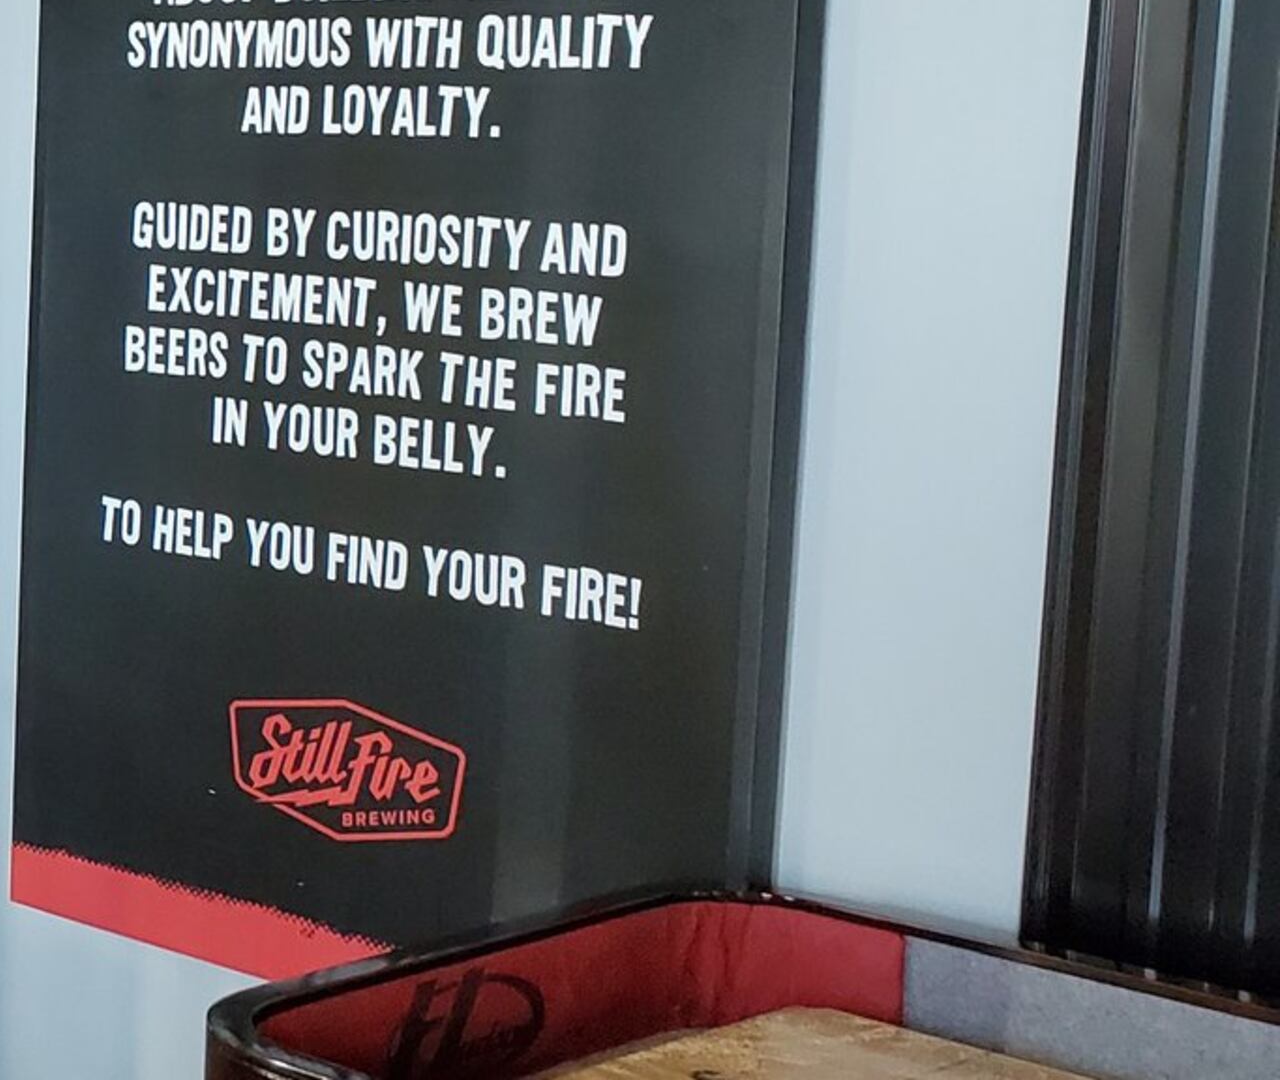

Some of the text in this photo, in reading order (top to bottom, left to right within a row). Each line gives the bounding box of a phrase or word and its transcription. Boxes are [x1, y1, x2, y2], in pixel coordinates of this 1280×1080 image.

[127, 12, 654, 71] SYNONYMOUS WITH QUALITY
[240, 84, 501, 138] AND LOYALTY.
[132, 201, 628, 277] GUIDED BY CURIOSITY AND
[147, 263, 603, 347] EXCITEMENT, WE BREW
[124, 325, 626, 423] BEERS TO SPARK THE FIRE
[212, 396, 507, 479] IN YOUR BELLY.
[101, 495, 642, 630] TO HELP YOU FIND YOUR FIRE!
[341, 808, 436, 828] BREWING
